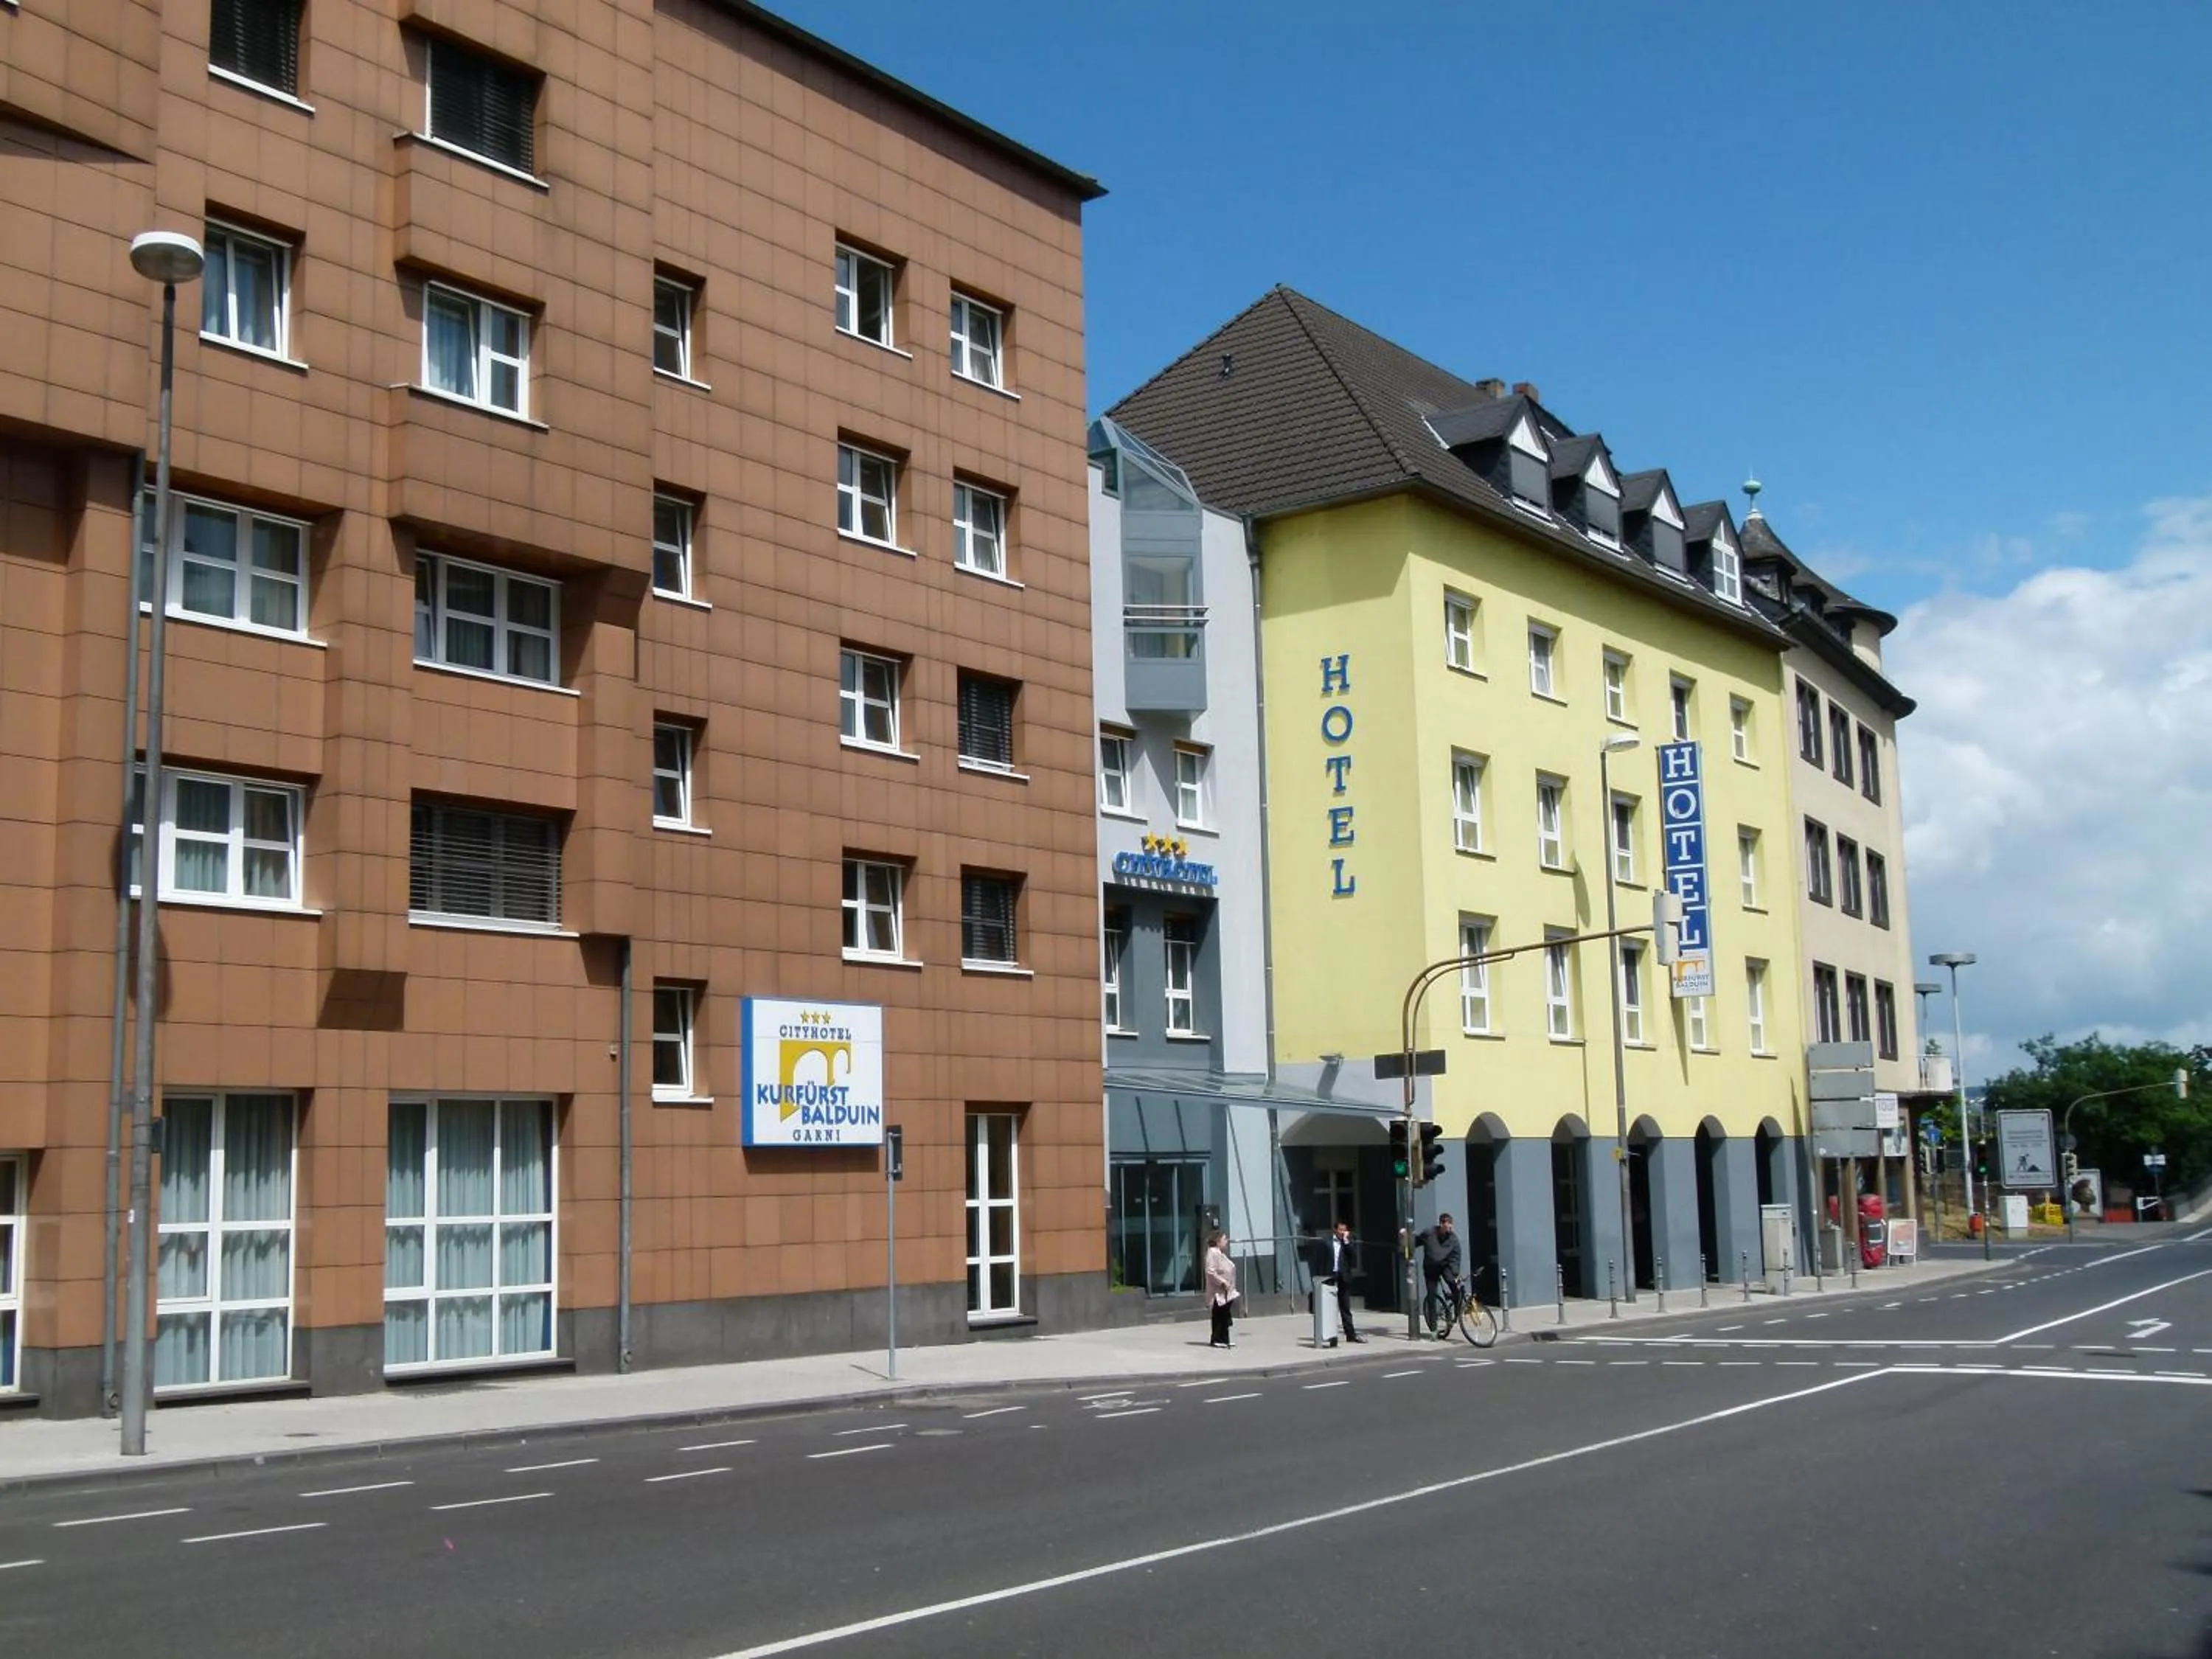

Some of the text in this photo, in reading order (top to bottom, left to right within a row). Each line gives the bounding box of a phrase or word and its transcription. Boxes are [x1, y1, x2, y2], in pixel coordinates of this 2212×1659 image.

[1320, 654, 1355, 896] HOTEL
[1664, 746, 1700, 946] HOTEL
[779, 1024, 852, 1040] CITYHOTEL
[757, 1081, 849, 1106] KURFÜRST
[801, 1105, 880, 1125] BALDUIN
[793, 1129, 841, 1142] GARNI
